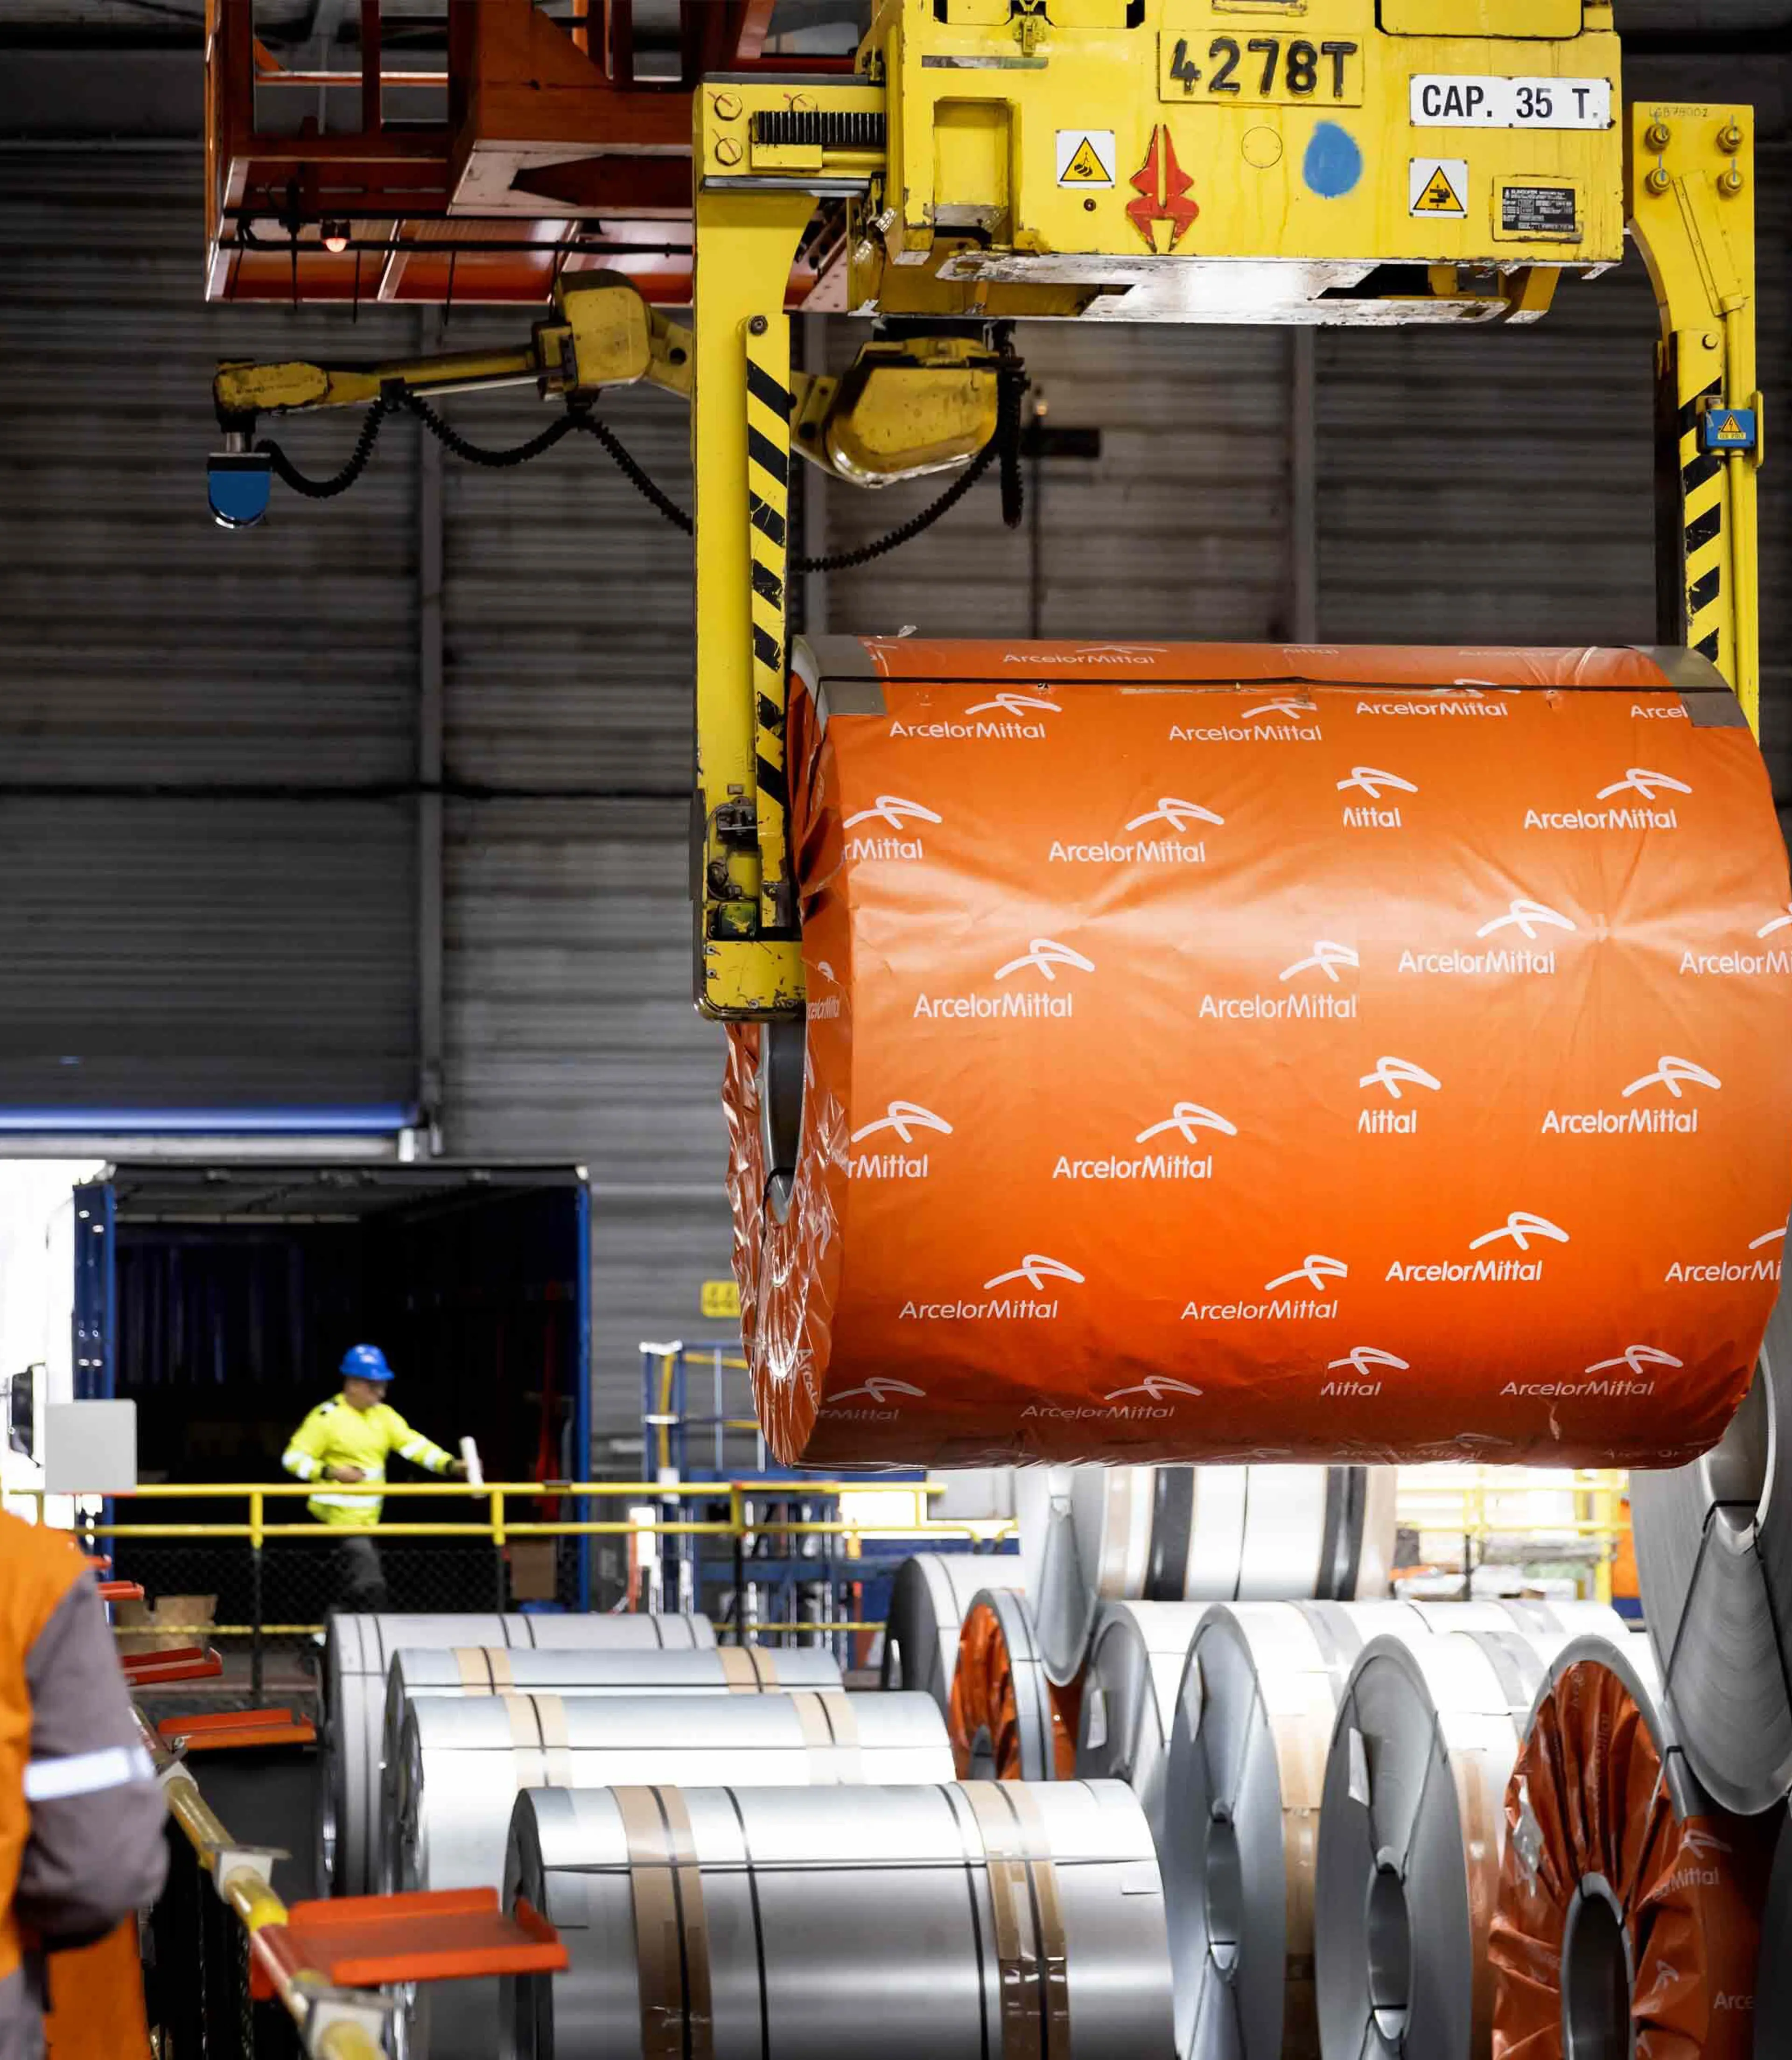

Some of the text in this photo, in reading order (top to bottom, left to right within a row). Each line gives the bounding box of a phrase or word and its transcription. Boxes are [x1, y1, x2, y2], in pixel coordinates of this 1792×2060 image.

[1170, 36, 1358, 98] 4278T
[1422, 84, 1492, 117] CAP.
[1516, 87, 1553, 118] 35
[1003, 653, 1155, 664] ArcelorMittal
[1356, 702, 1508, 716] ArcelorMittal
[889, 722, 1046, 739] ArcelorMittal
[1169, 726, 1322, 741] ArcelorMittal
[1524, 809, 1678, 829] ArcelorMittal
[1049, 841, 1206, 863] ArcelorMittal
[1398, 951, 1555, 974] ArcelorMittal
[914, 993, 1072, 1018] ArcelorMittal
[1199, 994, 1357, 1018] ArcelorMittal
[1542, 1109, 1698, 1134] ArcelorMittal
[1052, 1155, 1213, 1179] ArcelorMittal
[1385, 1261, 1543, 1282] ArcelorMittal
[899, 1300, 1058, 1319] ArcelorMittal
[1181, 1300, 1338, 1320] ArcelorMittal
[1500, 1381, 1655, 1396] ArcelorMittal
[1021, 1406, 1175, 1419] ArcelorMittal
